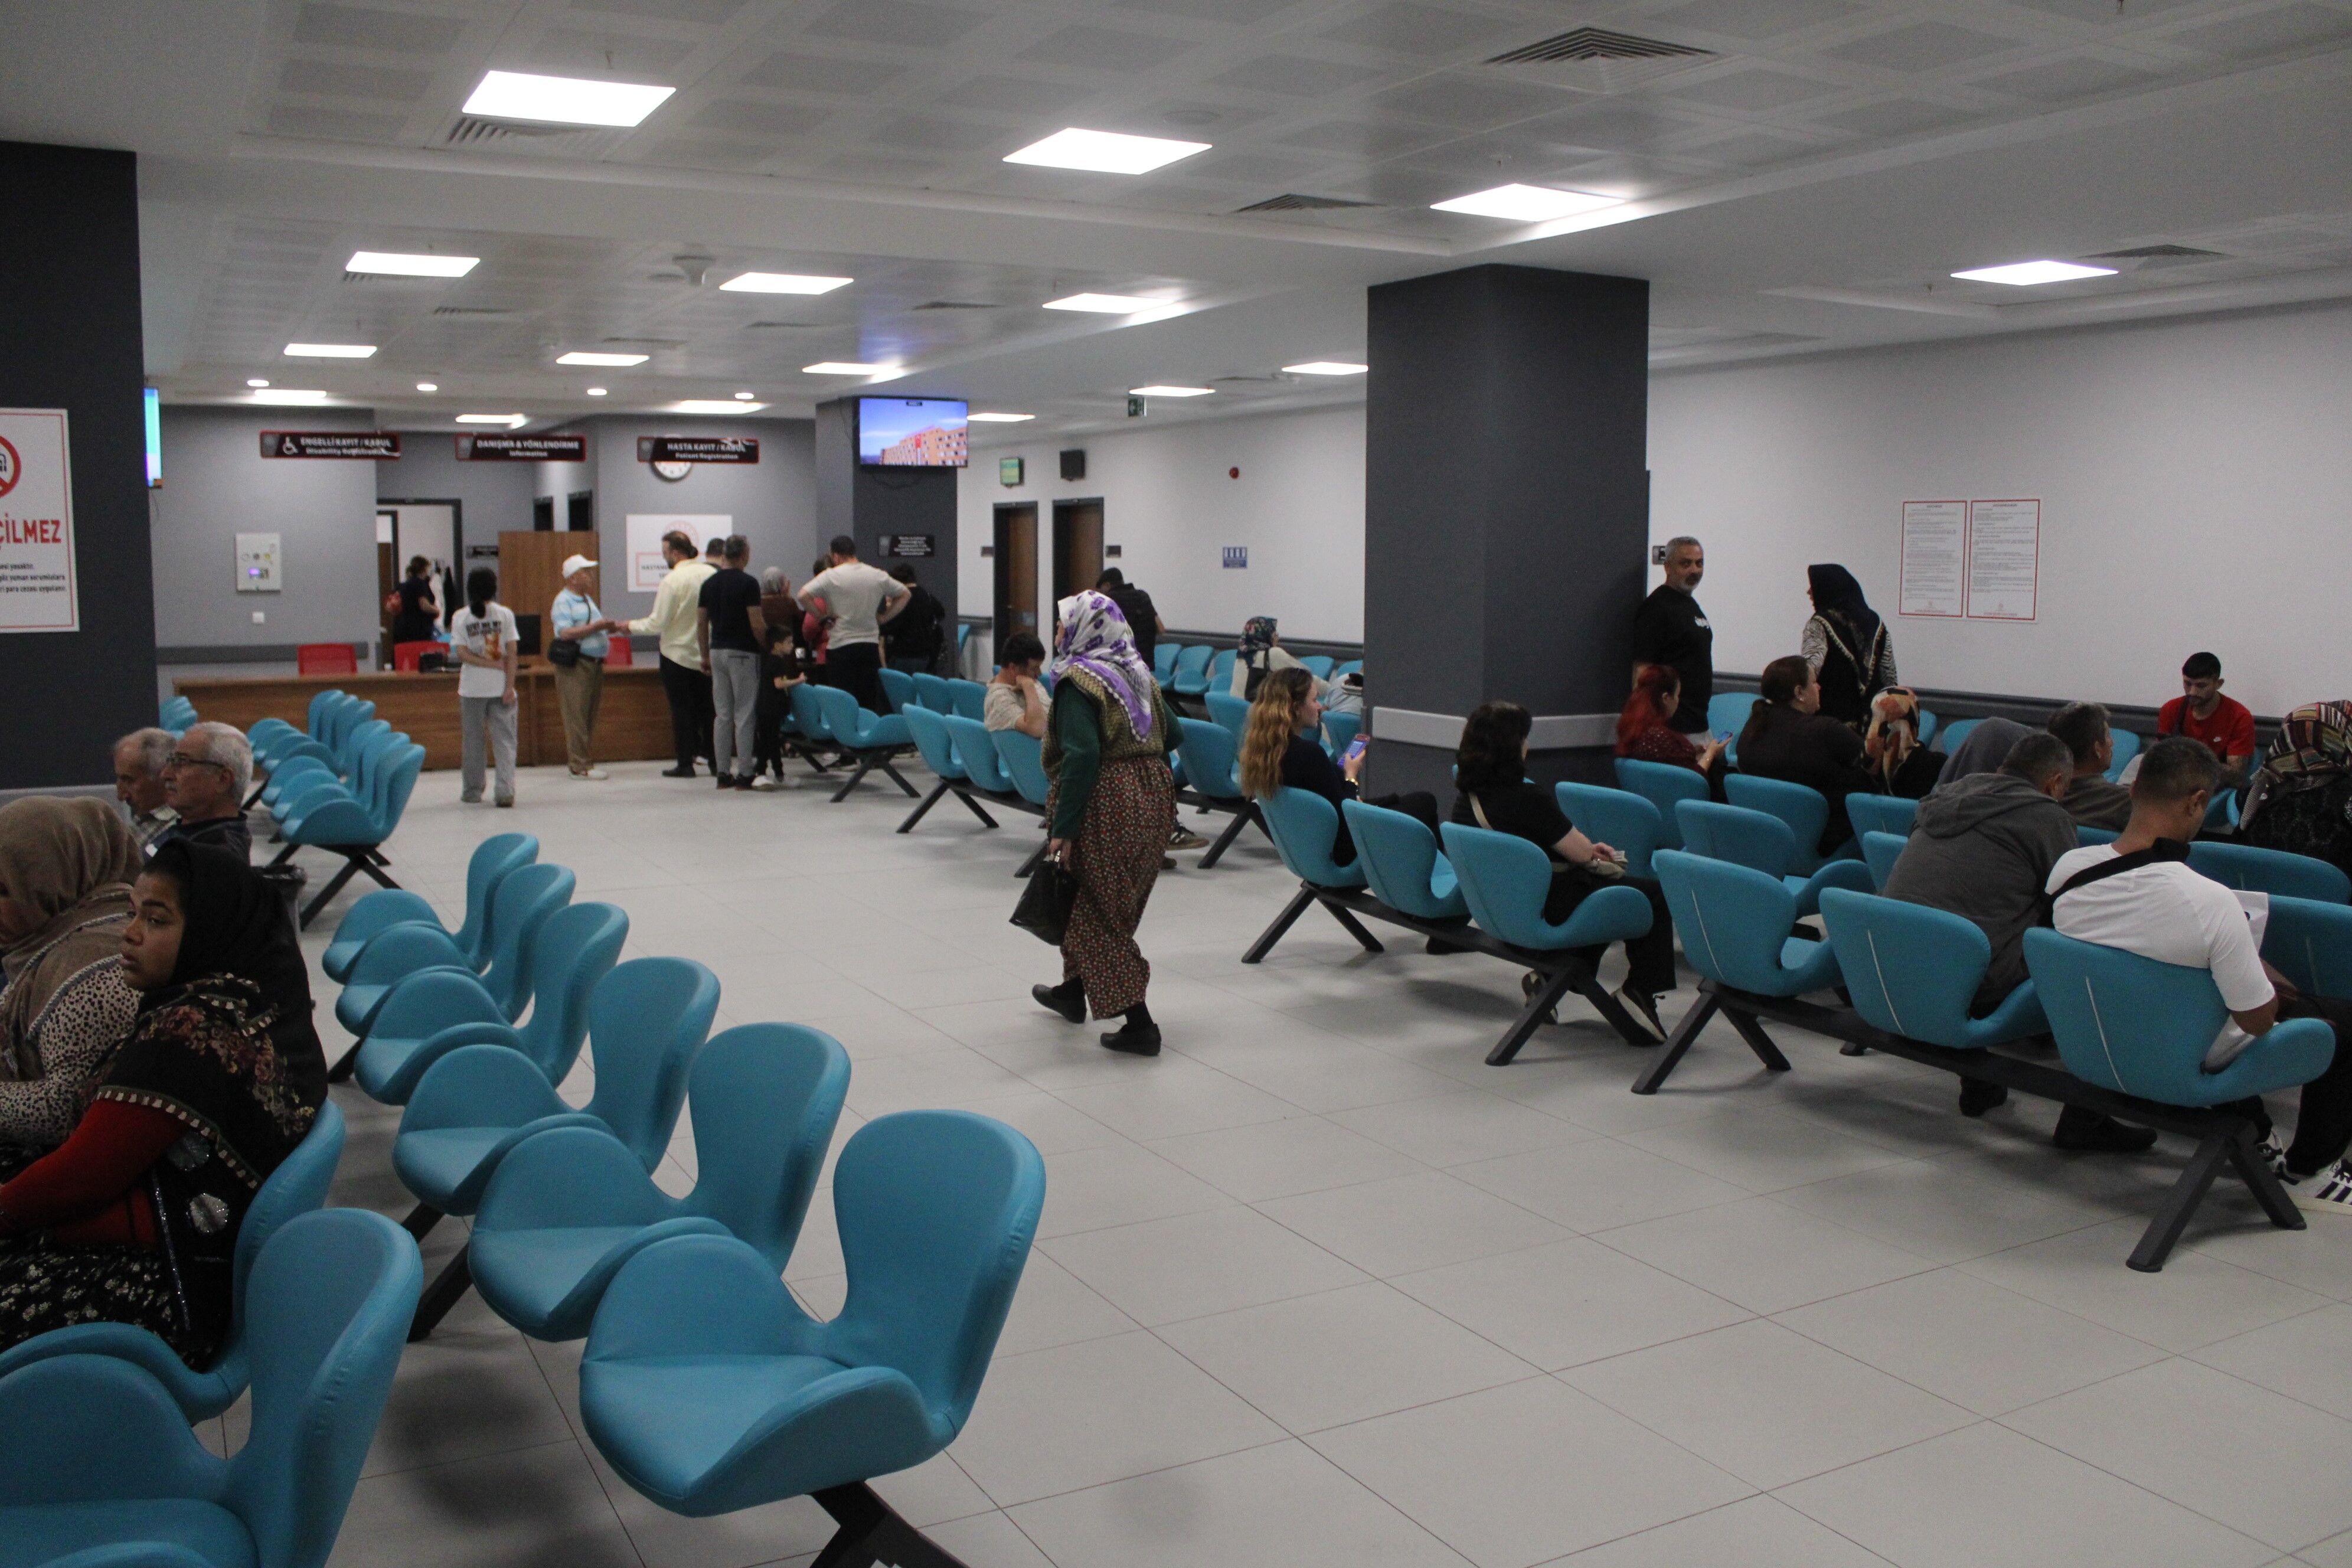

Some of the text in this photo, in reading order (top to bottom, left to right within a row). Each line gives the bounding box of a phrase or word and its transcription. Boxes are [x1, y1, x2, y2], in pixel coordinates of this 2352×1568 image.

[476, 439, 514, 449] DANIŞMA
[522, 439, 579, 449] YÖNLENDİRME
[667, 443, 692, 451] HASTA
[693, 443, 716, 451] KAYIT
